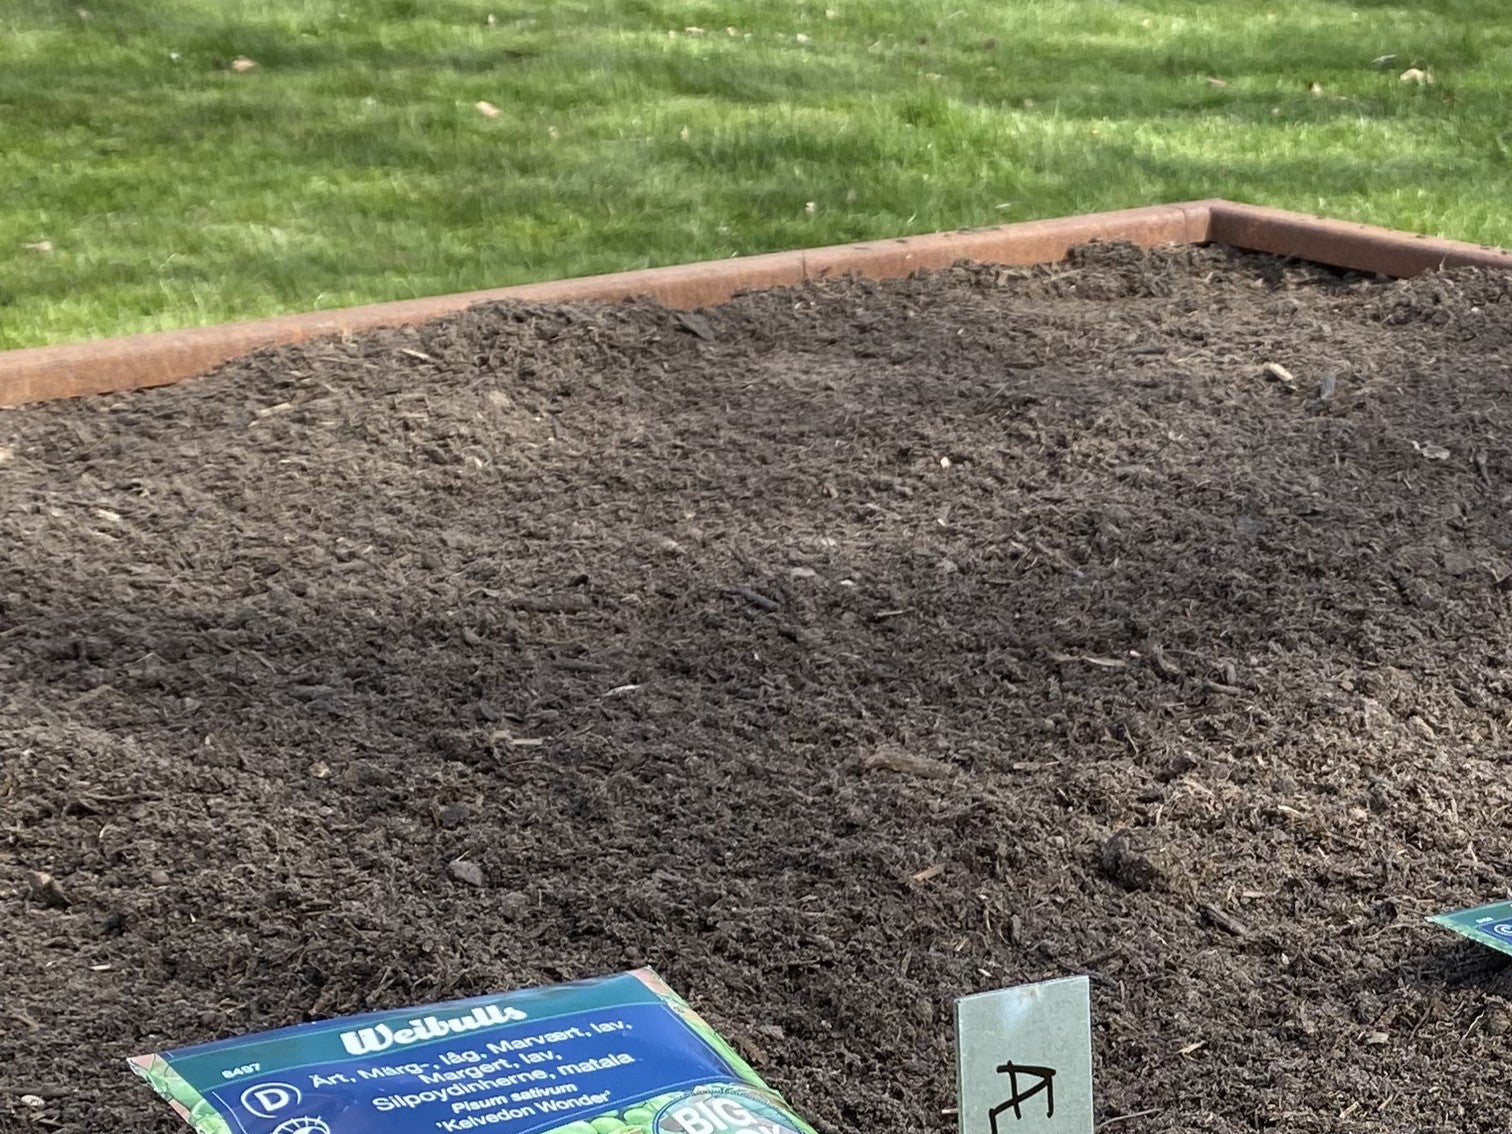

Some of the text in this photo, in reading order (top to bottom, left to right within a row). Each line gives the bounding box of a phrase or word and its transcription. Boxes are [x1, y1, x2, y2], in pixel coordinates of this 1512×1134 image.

[340, 1005, 527, 1055] Weibulls
[308, 1072, 357, 1089] Ärt,
[438, 1050, 488, 1067] låg,
[589, 1019, 633, 1034] lav,
[418, 1049, 563, 1085] Margert, lav,
[556, 1052, 636, 1076] matala
[254, 1088, 290, 1112] D
[451, 1082, 578, 1114] Pisum sativum
